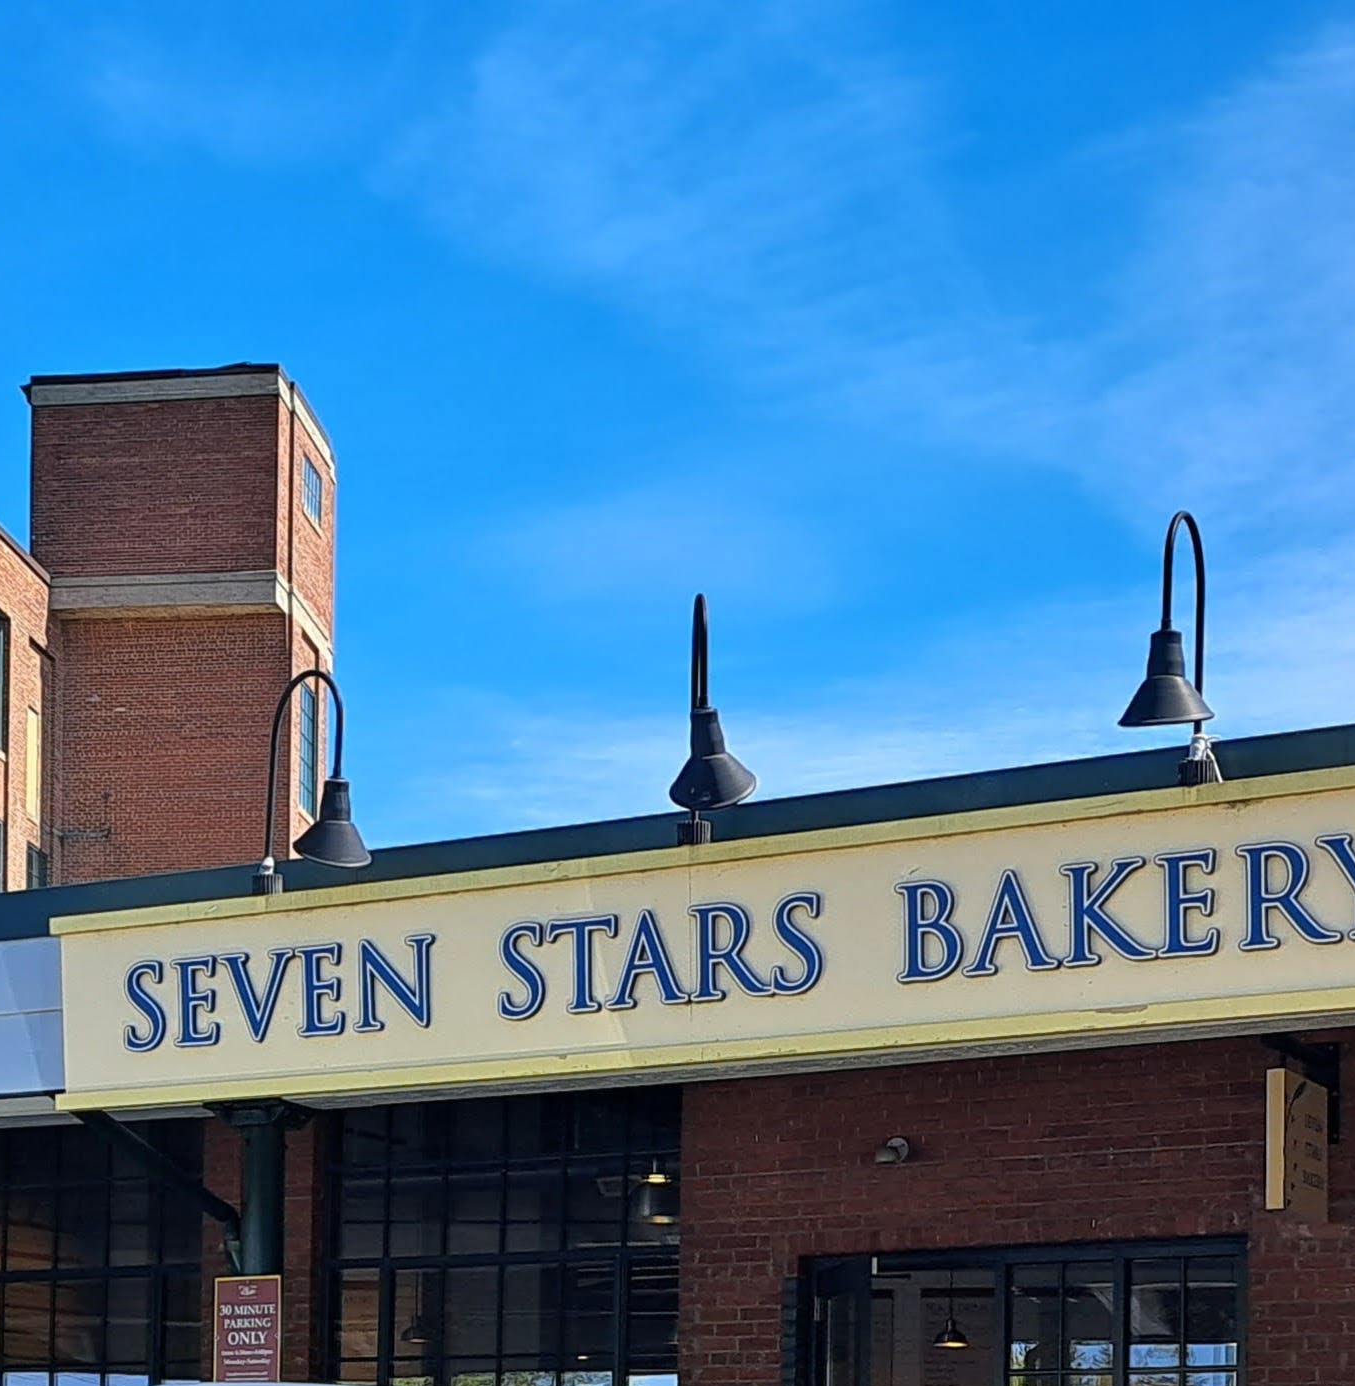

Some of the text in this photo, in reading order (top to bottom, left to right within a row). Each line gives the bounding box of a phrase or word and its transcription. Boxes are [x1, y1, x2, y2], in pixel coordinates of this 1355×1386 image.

[123, 933, 436, 1052] SEVEN
[496, 890, 824, 1021] STARS
[219, 1303, 276, 1316] 30 MINUTE
[223, 1318, 271, 1329] PARKING
[227, 1331, 267, 1345] ONLY
